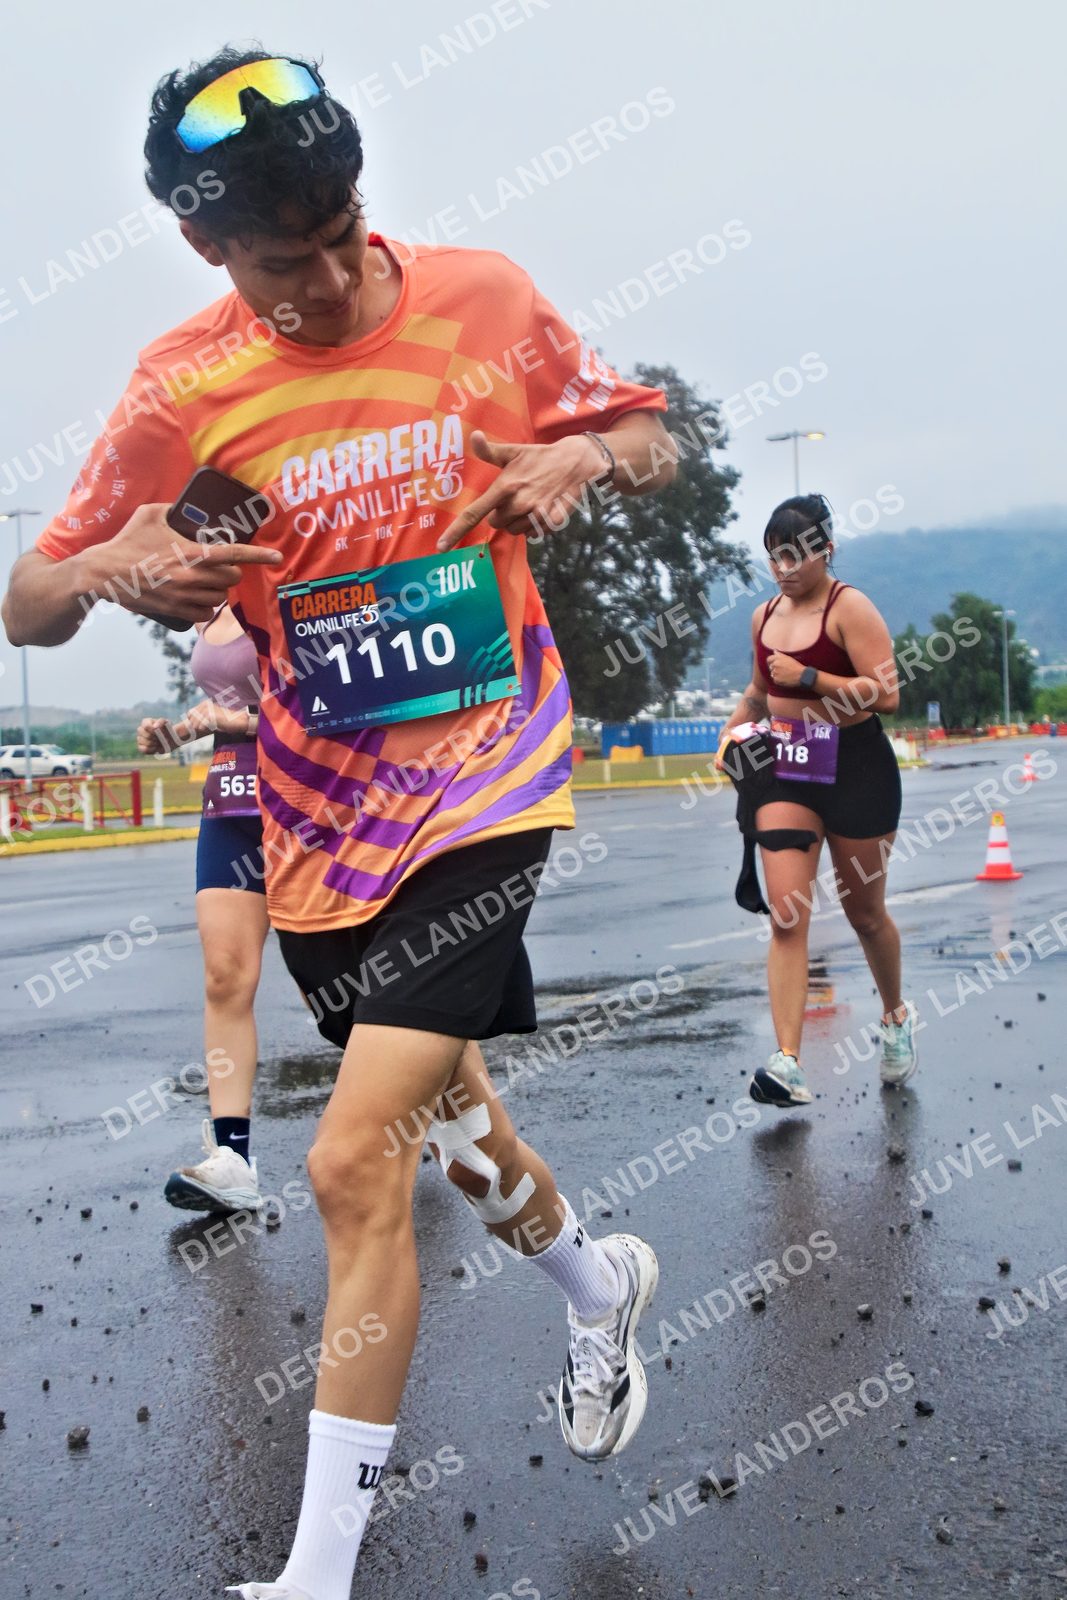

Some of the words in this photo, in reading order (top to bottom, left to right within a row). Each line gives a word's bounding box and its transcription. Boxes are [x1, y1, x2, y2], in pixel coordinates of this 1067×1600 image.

[282, 414, 464, 505] CARRERA
[294, 477, 430, 538] OMNILIFE
[375, 524, 393, 541] 10K
[418, 513, 435, 529] 15K
[437, 560, 476, 595] 10K
[291, 583, 377, 620] CARRERA
[295, 613, 360, 637] OMNILIFE
[327, 623, 456, 684] 1110
